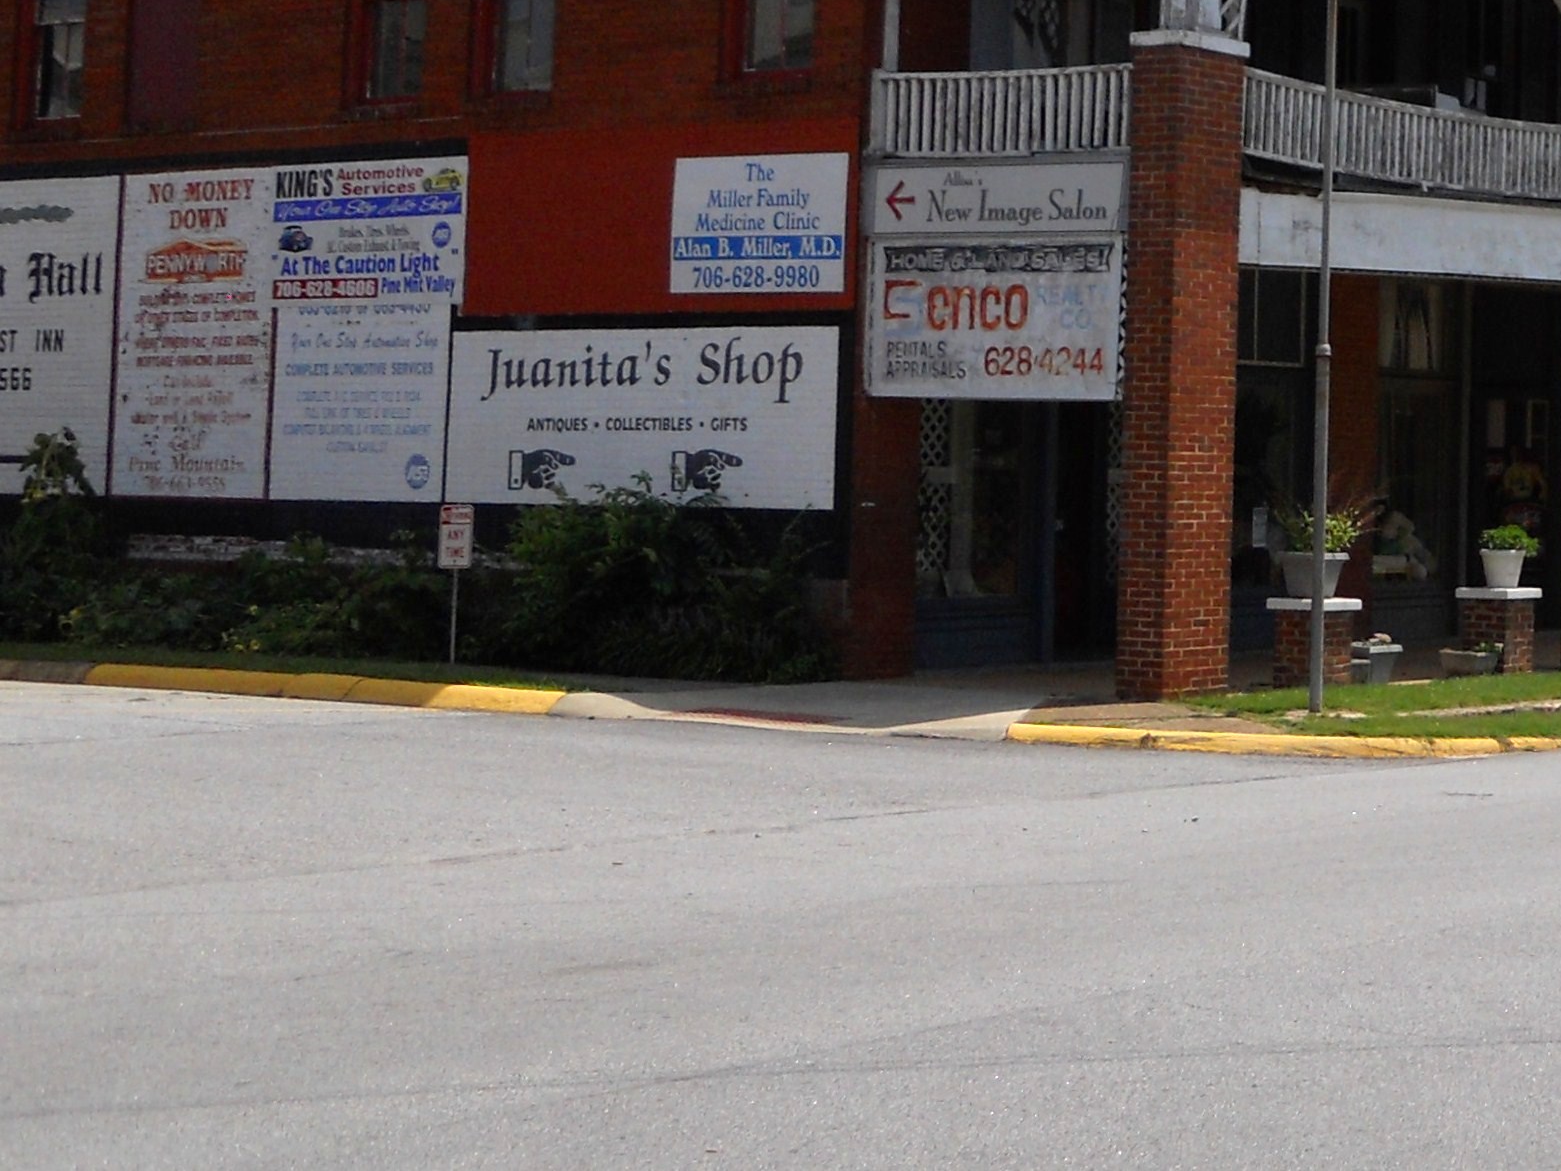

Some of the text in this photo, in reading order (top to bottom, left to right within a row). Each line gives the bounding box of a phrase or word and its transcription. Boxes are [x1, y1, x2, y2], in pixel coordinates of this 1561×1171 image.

[276, 168, 333, 198] KING'S
[337, 165, 424, 180] Automotive
[746, 163, 775, 182] The
[148, 179, 254, 204] NO MONEY
[342, 182, 416, 196] Services
[707, 188, 810, 209] Miller Family
[170, 207, 228, 229] DOWN
[926, 188, 1107, 226] New Image Salon
[695, 212, 821, 231] Medicine Clinic
[675, 237, 840, 259] Alan B. Miller, M.D.
[147, 251, 246, 274] PENNYWRTH
[303, 256, 330, 275] The
[335, 253, 396, 274] Caution
[891, 252, 944, 269] HOME
[27, 252, 102, 304] Hall
[381, 279, 400, 294] Pine
[426, 277, 455, 298] Valley
[693, 265, 820, 288] 706-628-9980
[276, 280, 376, 297] 706-628-4606
[1036, 283, 1110, 306] REALT
[35, 330, 64, 352] INN
[887, 340, 947, 358] RENTALS
[480, 336, 804, 403] Juanita's Shop
[887, 360, 967, 379] APPRAISALS
[527, 417, 748, 432] ANTIQUES COLLECTIBLES GIFTS
